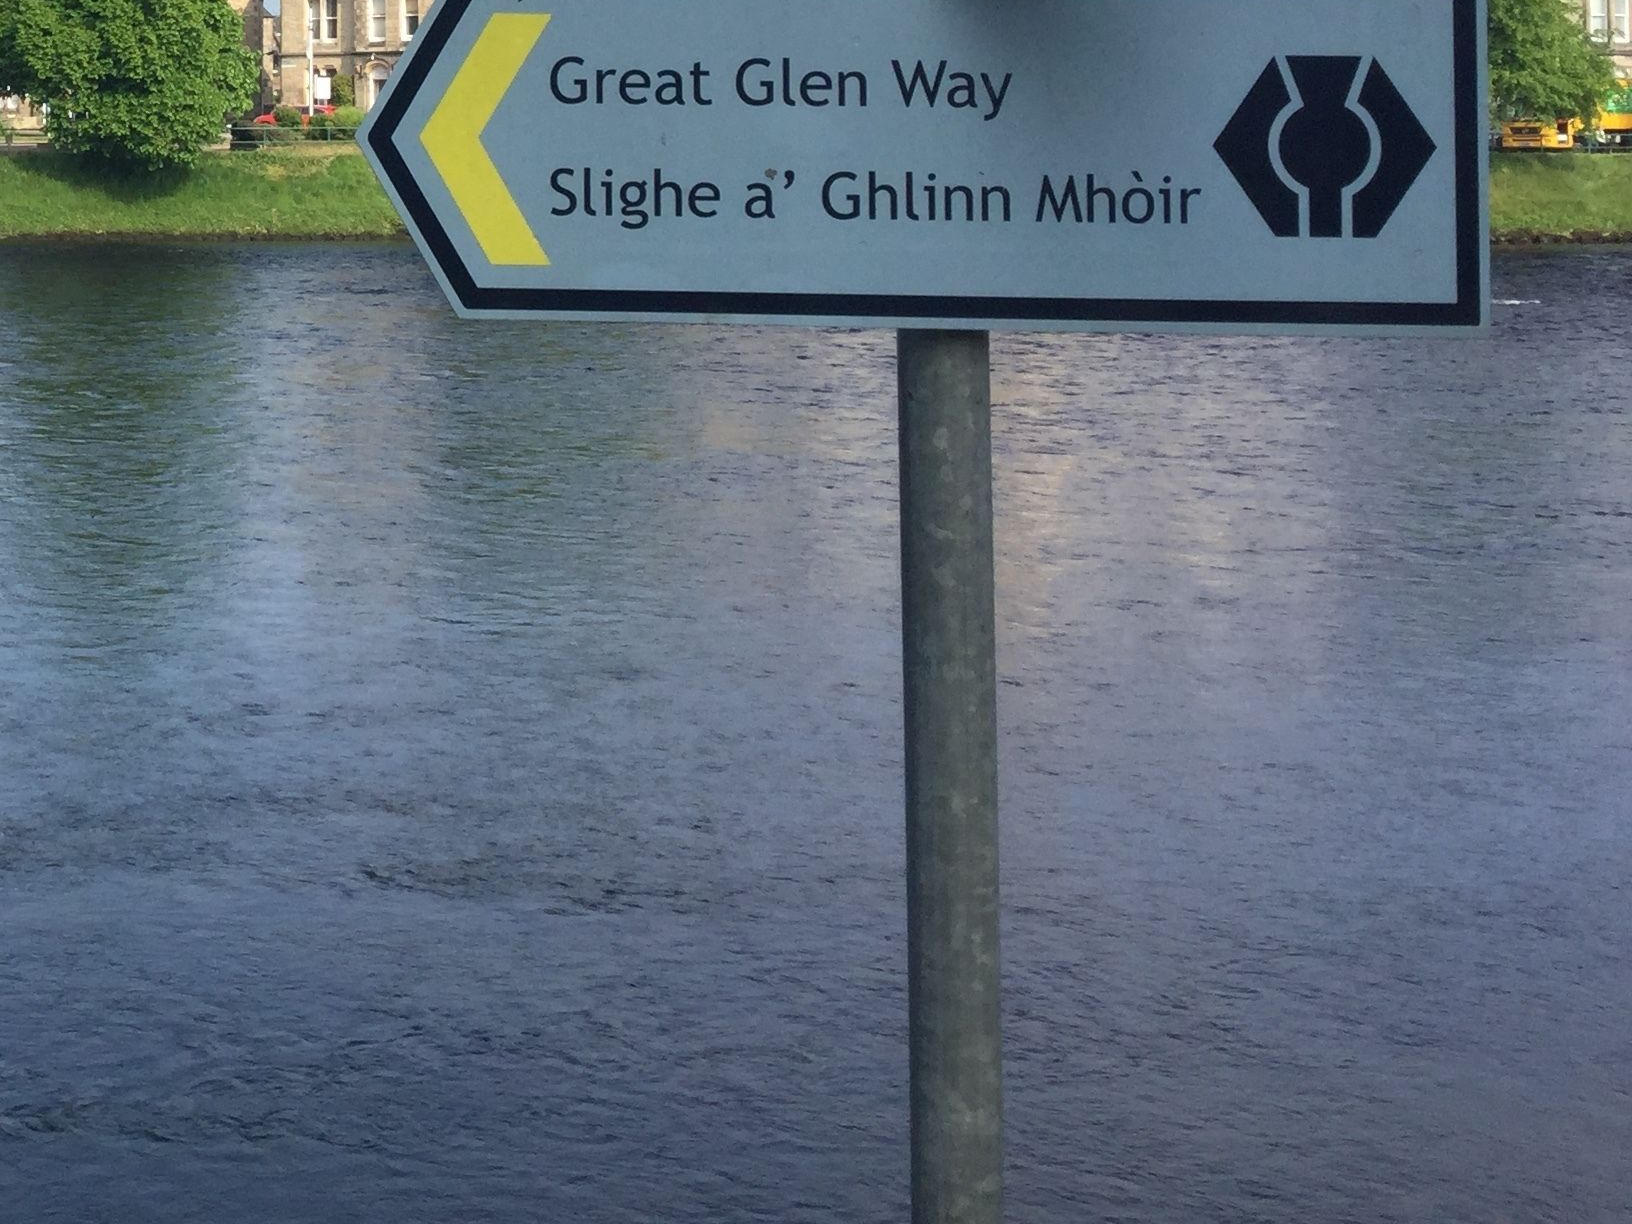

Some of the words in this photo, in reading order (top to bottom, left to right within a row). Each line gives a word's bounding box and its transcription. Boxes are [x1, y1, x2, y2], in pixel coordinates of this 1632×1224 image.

[549, 55, 713, 106] Great
[735, 57, 868, 107] Glen
[891, 59, 1013, 122] Way
[550, 167, 721, 230] Slighe
[821, 170, 1011, 222] Ghlinn
[1035, 170, 1202, 225] Mhòir
